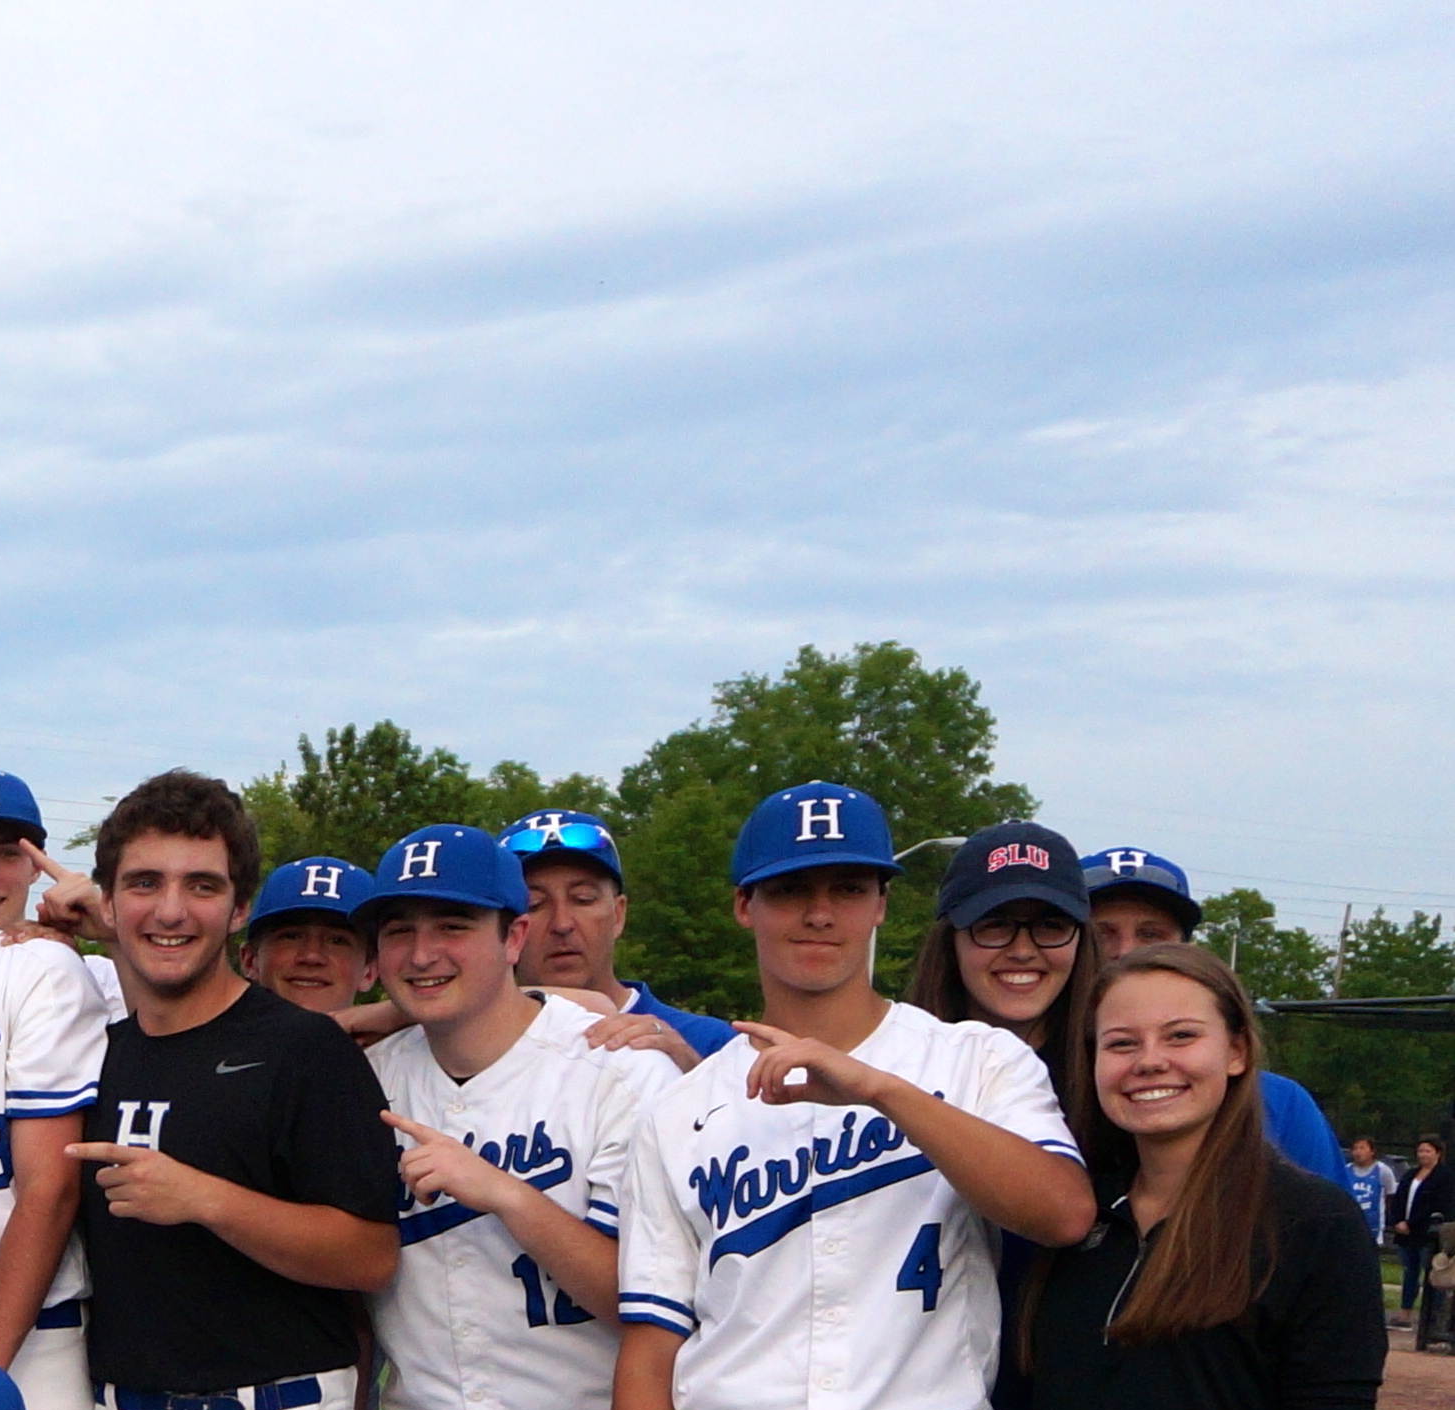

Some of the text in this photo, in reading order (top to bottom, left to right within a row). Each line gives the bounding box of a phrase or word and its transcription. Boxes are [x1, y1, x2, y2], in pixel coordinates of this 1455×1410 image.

[795, 798, 846, 841] H
[397, 840, 442, 880] H
[987, 844, 1050, 873] SLU
[1107, 851, 1147, 876] H
[300, 865, 343, 899] H
[116, 1101, 171, 1151] H
[896, 1223, 942, 1312] 4
